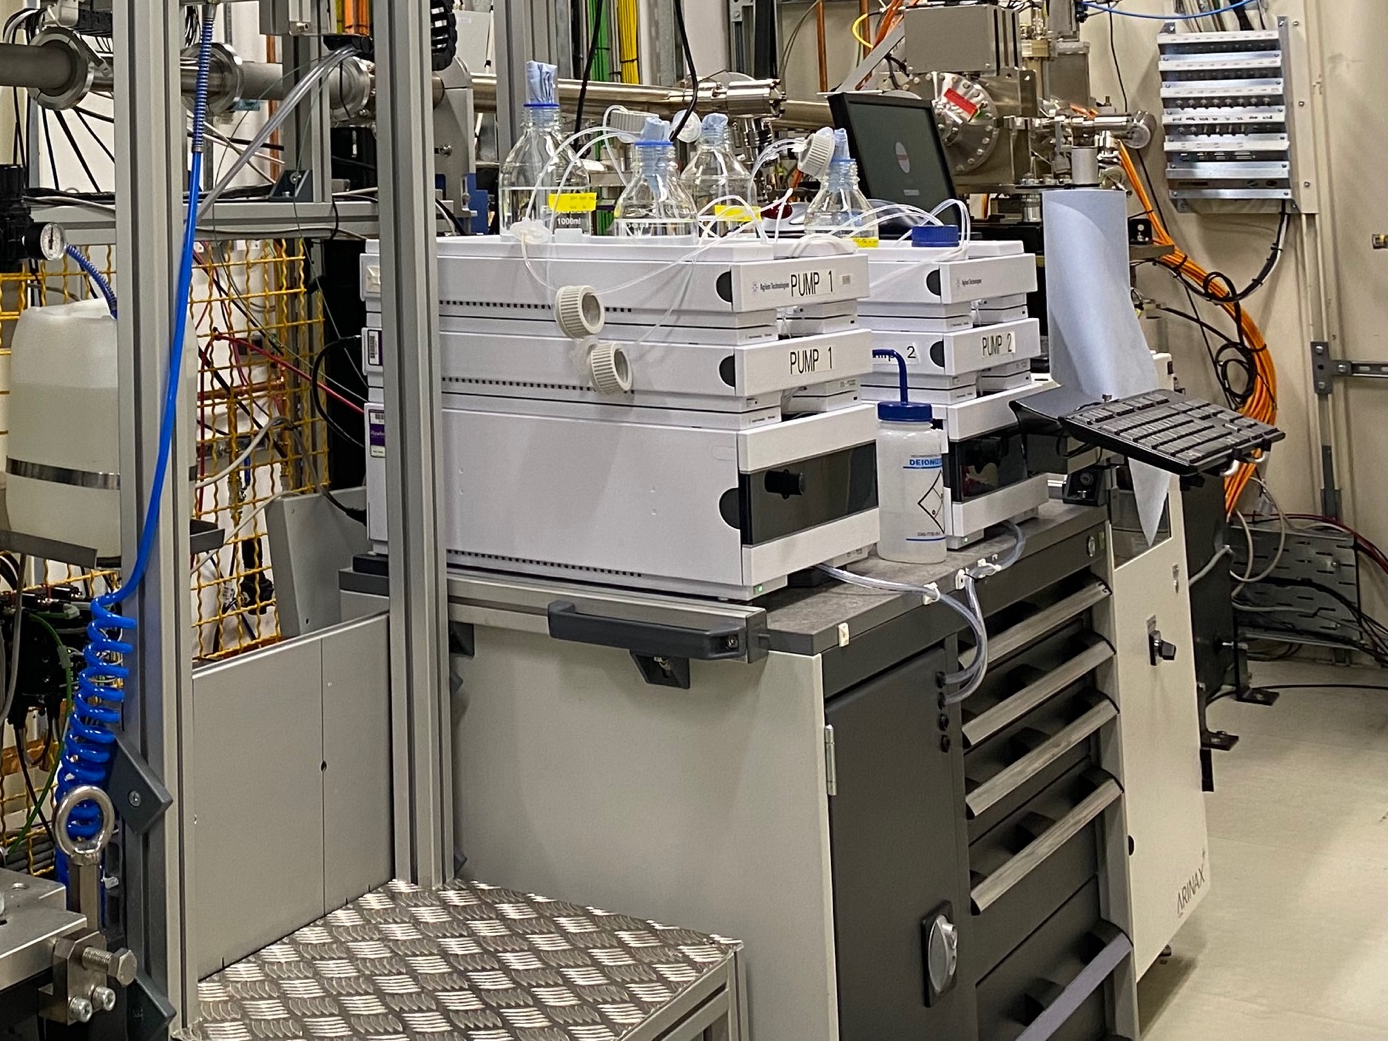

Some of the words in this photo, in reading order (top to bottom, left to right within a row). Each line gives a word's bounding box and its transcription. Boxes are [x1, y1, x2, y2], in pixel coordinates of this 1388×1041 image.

[557, 217, 581, 226] 1000ml
[790, 271, 820, 297] PUMP
[828, 270, 833, 293] 1
[906, 345, 916, 359] 2
[982, 332, 1003, 357] PUMP
[1006, 333, 1012, 353] 2
[790, 348, 819, 375] PUMP
[827, 346, 832, 369] 1
[1177, 863, 1205, 914] ARINAX
